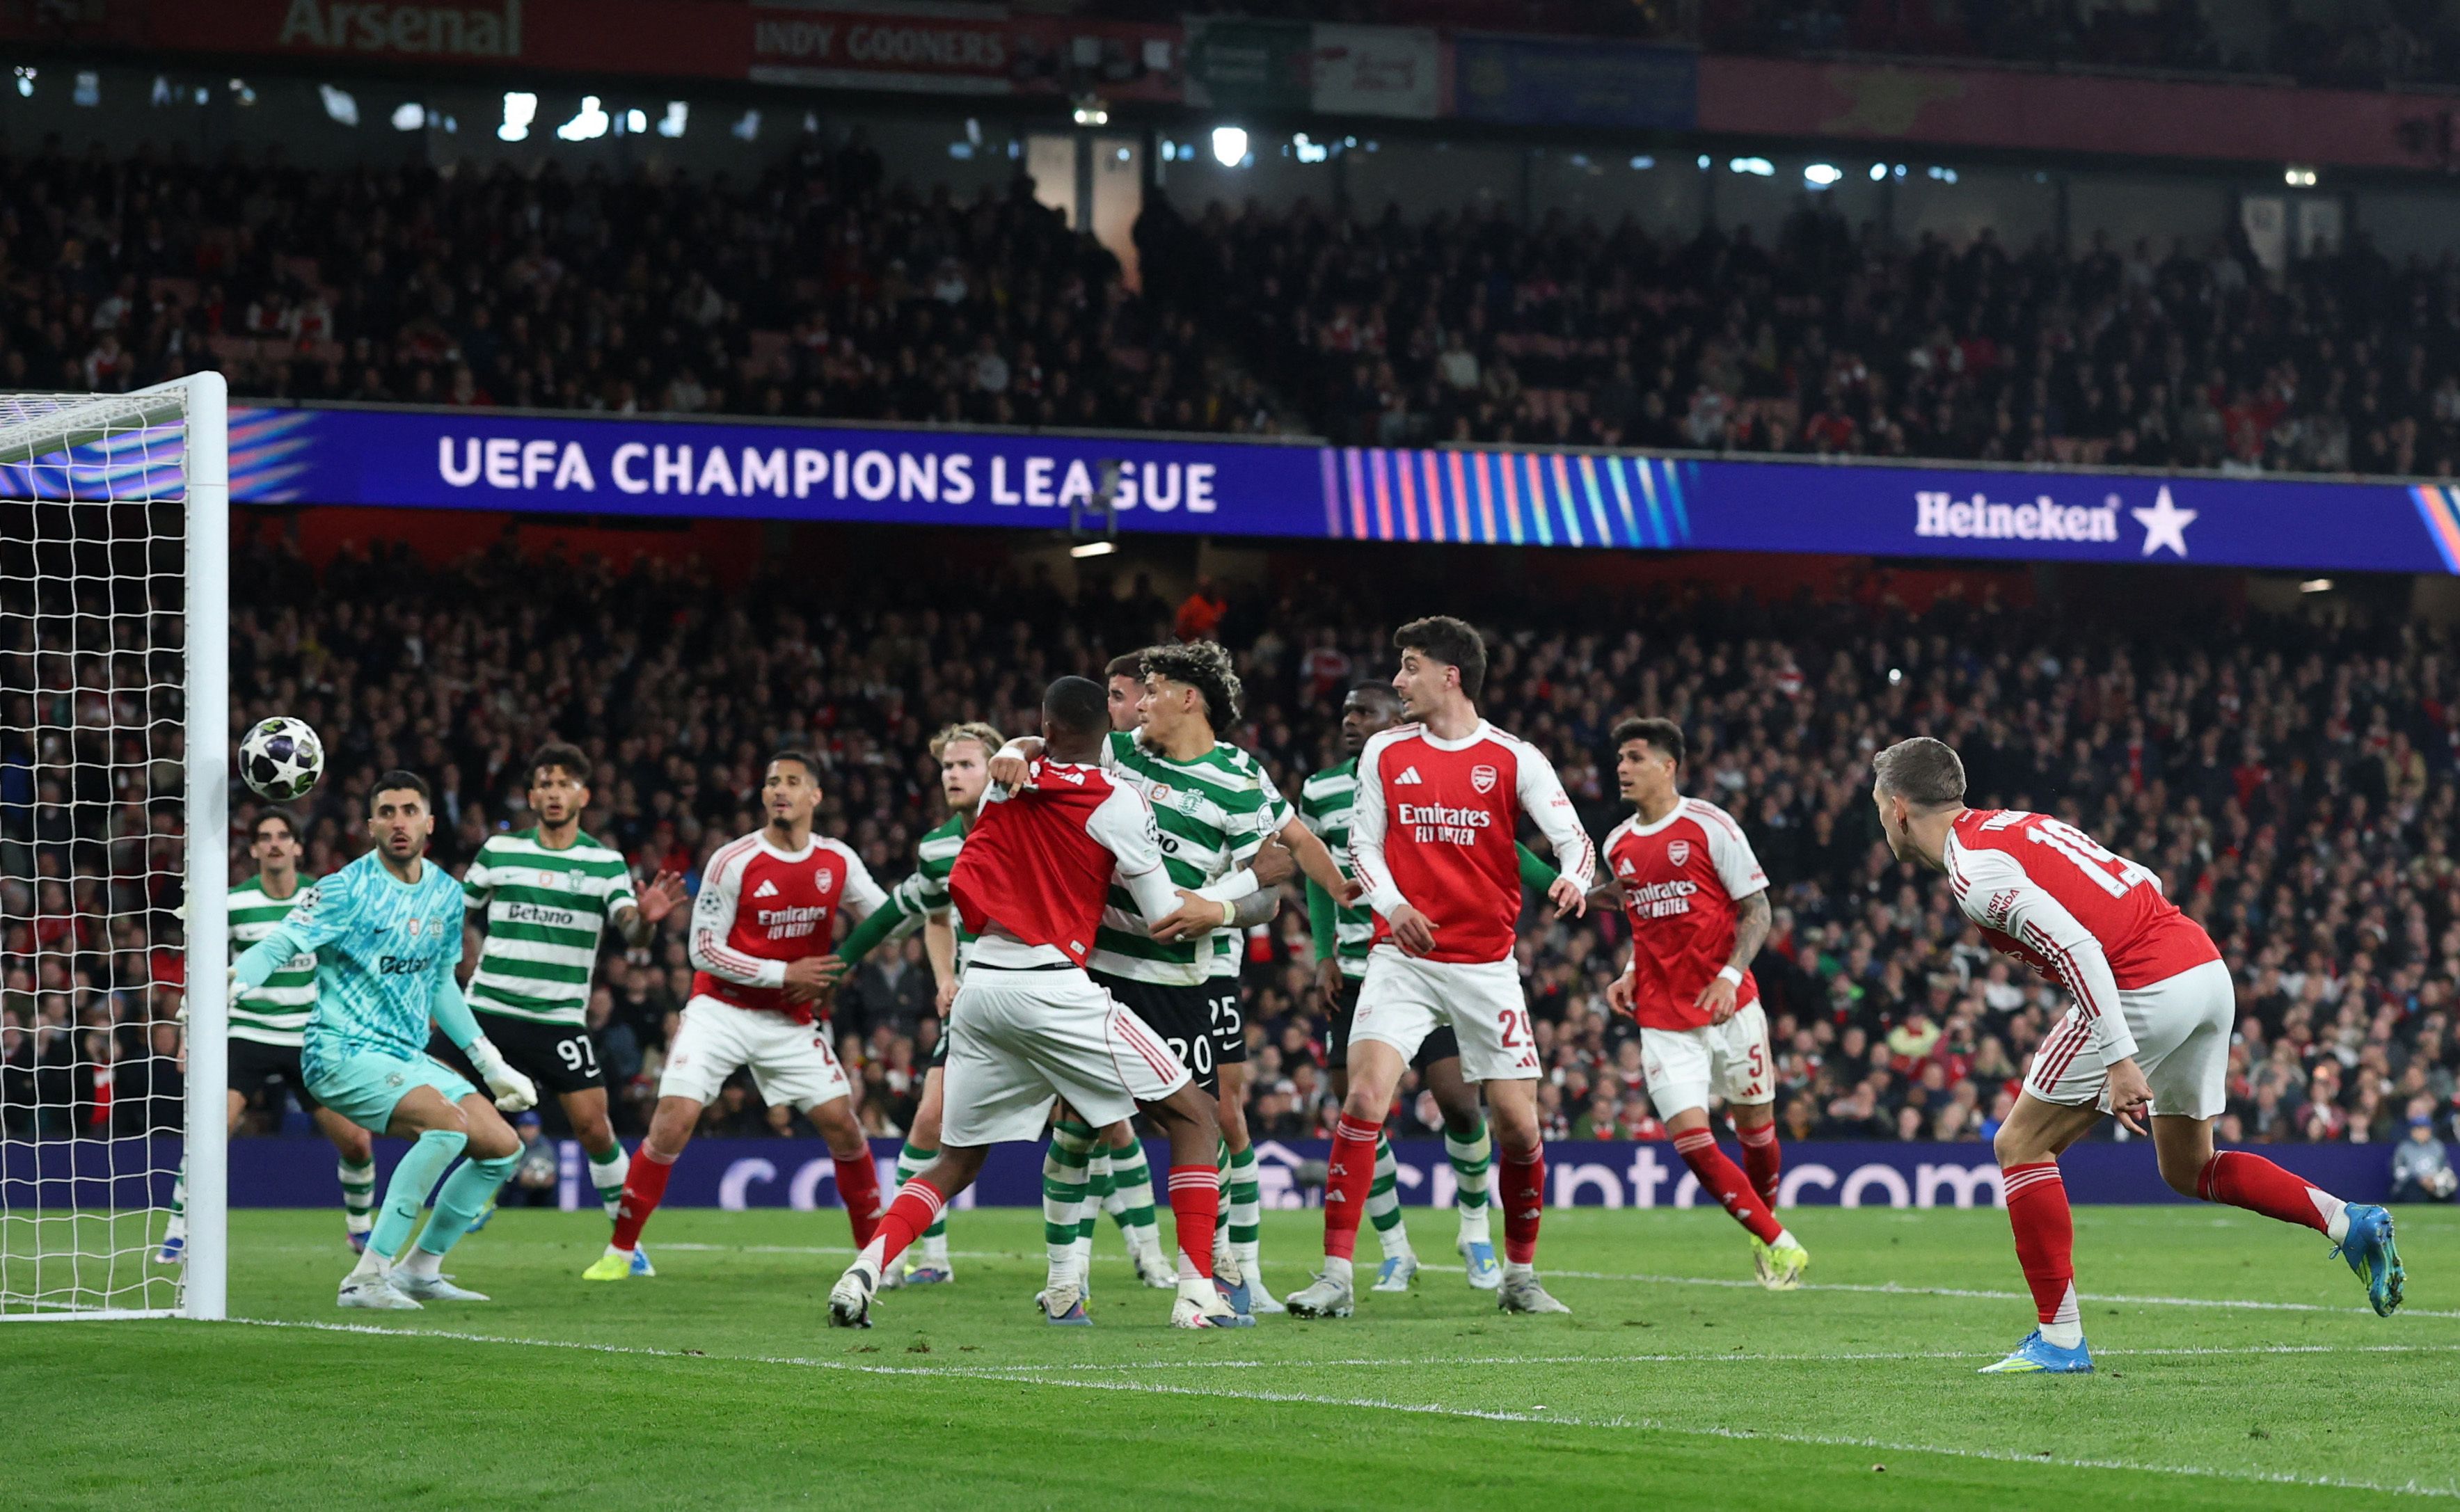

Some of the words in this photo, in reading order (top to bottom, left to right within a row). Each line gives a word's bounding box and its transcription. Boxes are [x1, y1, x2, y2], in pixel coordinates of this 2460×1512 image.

[278, 0, 519, 56] Arsenal
[754, 21, 835, 57] INDY
[845, 26, 1005, 68] GOONERS
[438, 436, 596, 493] UEFA
[611, 442, 976, 506] CHAMPIONS
[990, 455, 1218, 514] LEAGUE
[1914, 491, 2120, 543] Heineken
[1398, 802, 1491, 828] Emirates
[1415, 825, 1435, 843] FLY
[2026, 818, 2145, 900] 19
[508, 903, 573, 925] Betano
[757, 905, 827, 926] Emirates
[1987, 892, 2003, 919] VISIT
[379, 955, 431, 975] Beta
[1208, 996, 1241, 1037] 25
[556, 1035, 596, 1071] 91
[813, 1037, 835, 1066] 2
[1166, 1034, 1212, 1075] 20
[1748, 1043, 1763, 1079] 5
